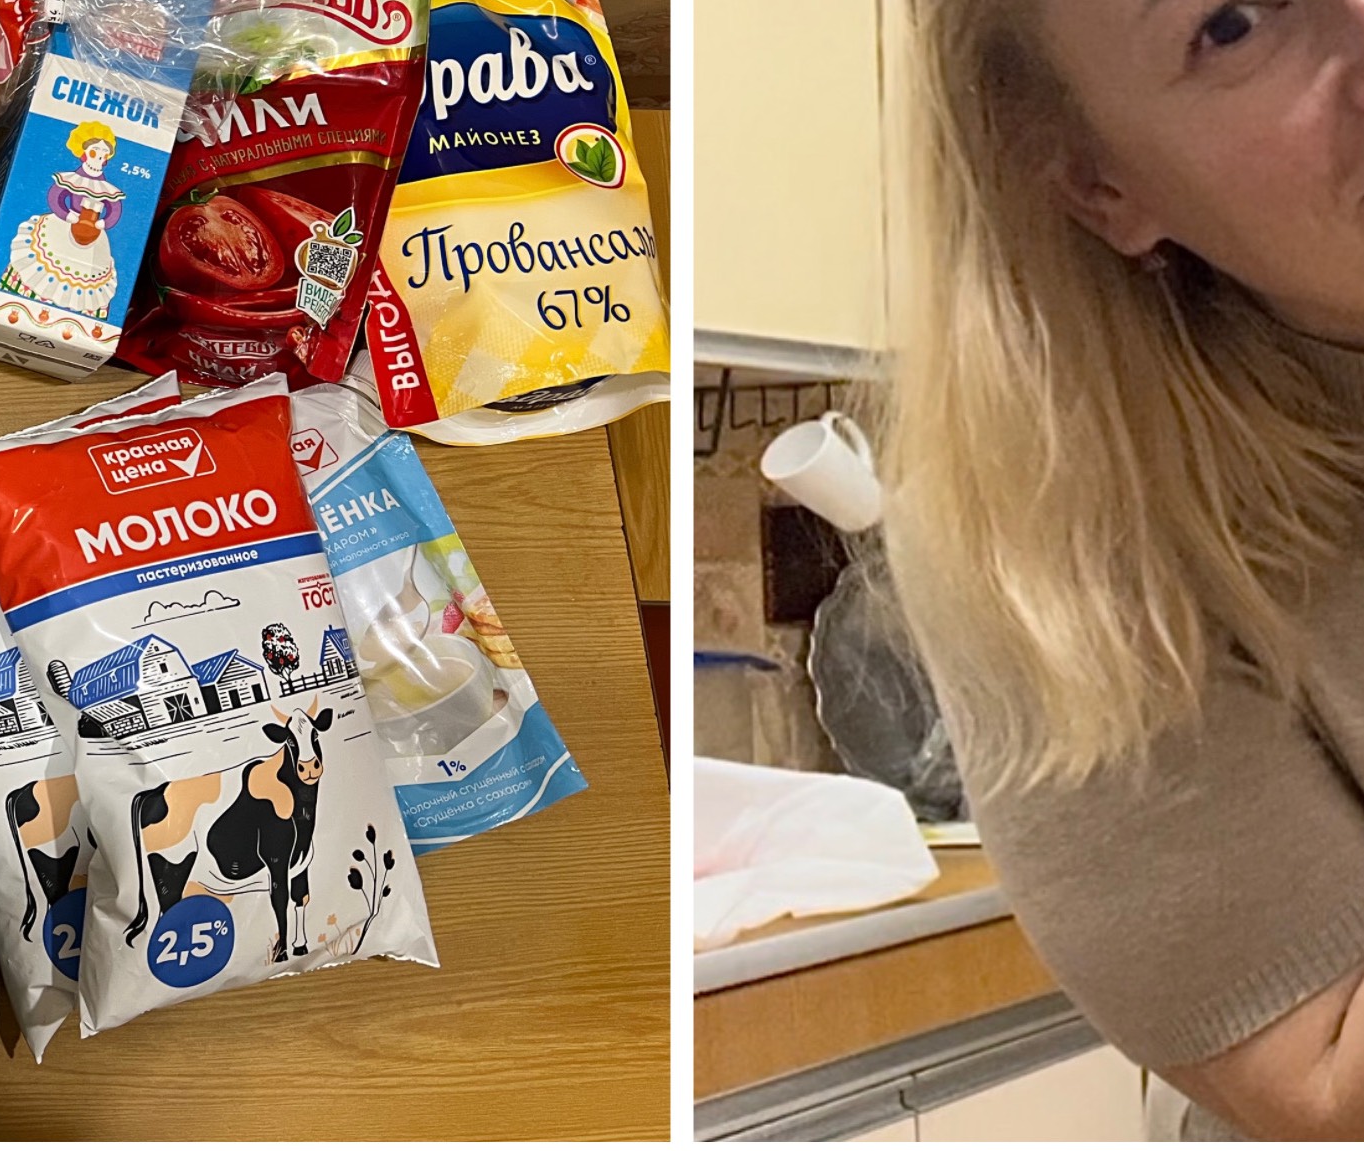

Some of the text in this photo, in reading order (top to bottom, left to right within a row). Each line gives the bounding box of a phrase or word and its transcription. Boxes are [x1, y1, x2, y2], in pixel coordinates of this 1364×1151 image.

[422, 27, 592, 121] рава
[51, 75, 163, 129] СНЕЖОК
[211, 134, 314, 167] НАТУРАЛЬНЫМИ
[428, 130, 542, 154] МАЙОНЕЗ
[120, 160, 152, 181] 2,5%
[535, 284, 633, 332] 67%
[102, 436, 194, 466] красная
[110, 460, 167, 485] цена
[74, 489, 278, 563] МОЛОКО
[318, 488, 401, 541] ЁНКА
[325, 526, 377, 556] ХАРОМ»
[339, 539, 388, 564] молочного
[136, 548, 259, 584] пастеризованное
[301, 587, 337, 611] ГОСТ
[437, 759, 467, 777] 1%
[403, 788, 459, 817] молочный
[459, 766, 520, 795] сгущенный
[156, 917, 229, 964] 2,5%
